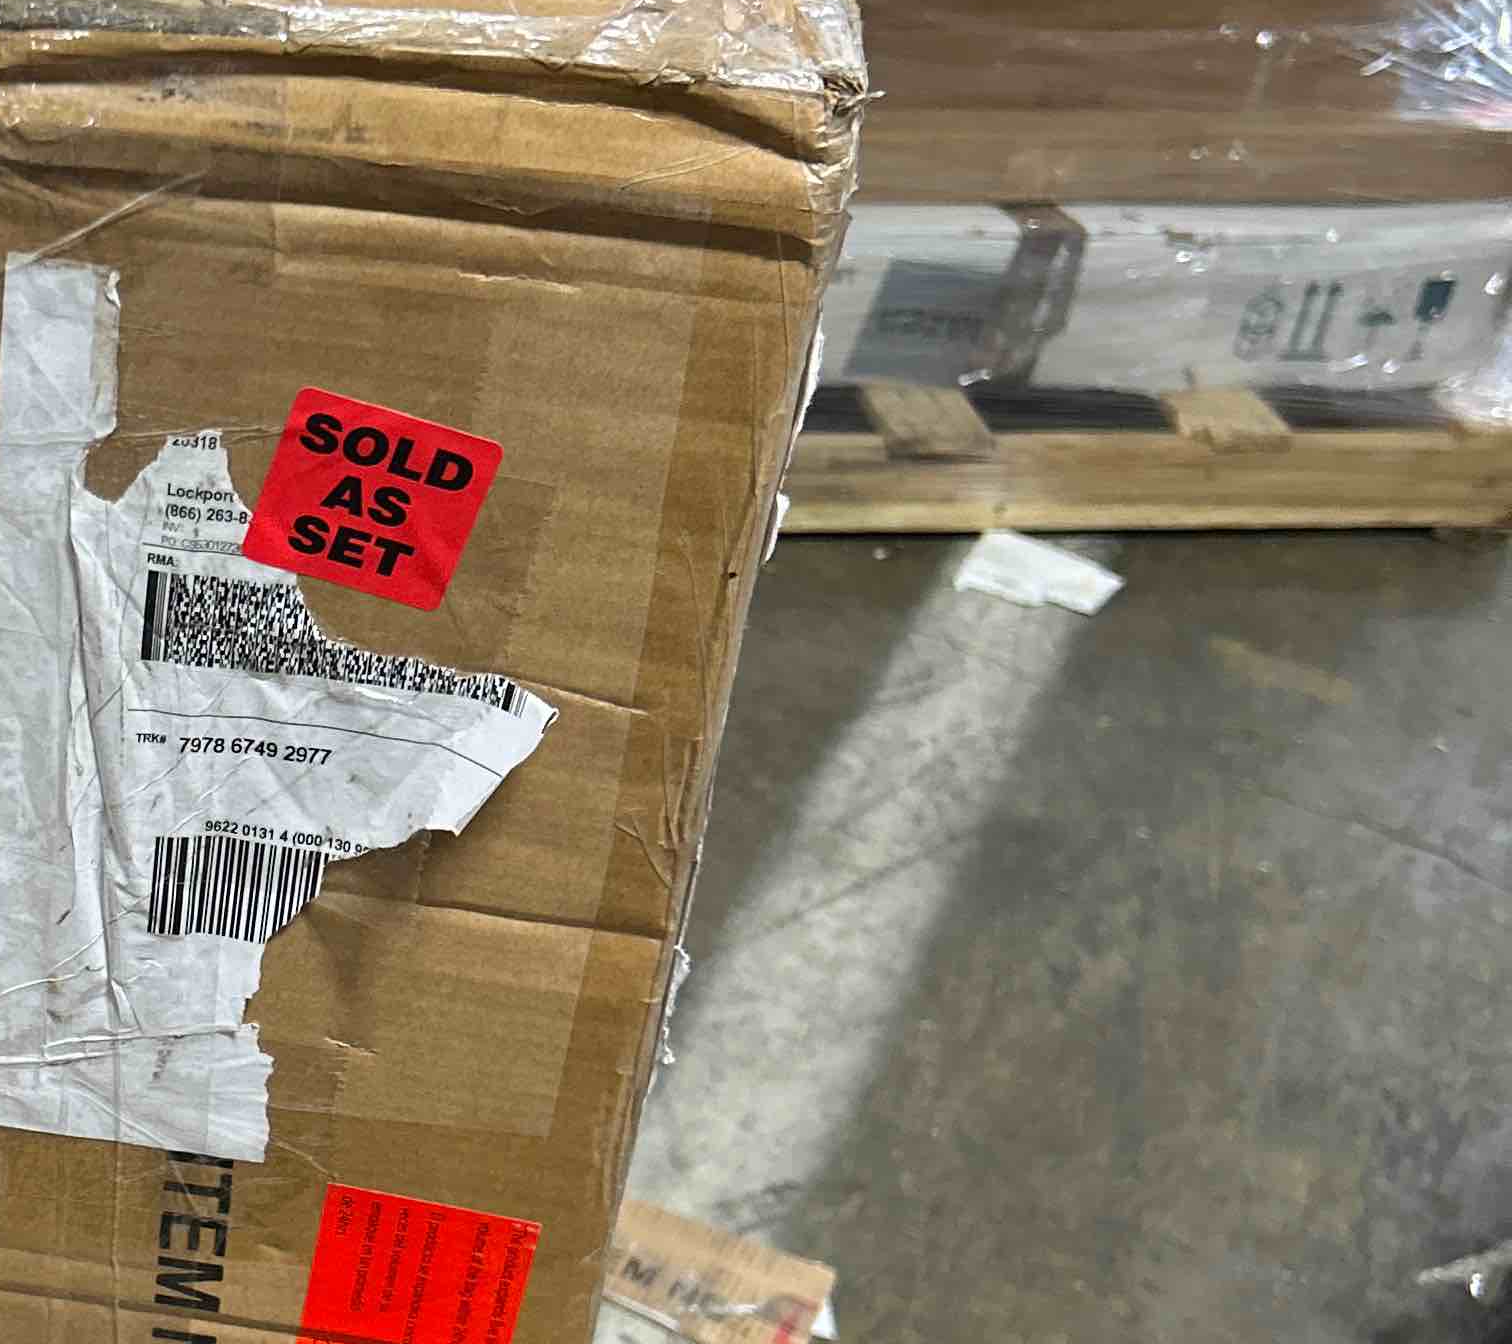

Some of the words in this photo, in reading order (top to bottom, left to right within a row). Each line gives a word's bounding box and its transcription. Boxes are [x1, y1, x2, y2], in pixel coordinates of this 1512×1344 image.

[299, 411, 474, 492] SOLD
[165, 504, 202, 524] (866)
[320, 475, 412, 528] AS
[288, 514, 416, 578] SET
[136, 732, 167, 744] TRK#
[179, 737, 225, 754] 7978
[231, 738, 278, 757] 6749
[283, 745, 332, 765] 2977
[205, 820, 238, 835] 9622
[242, 825, 274, 840] 0131
[280, 830, 288, 842] 4
[292, 832, 323, 847] (000
[327, 837, 351, 853] 130
[154, 1150, 234, 1313] ITEM
